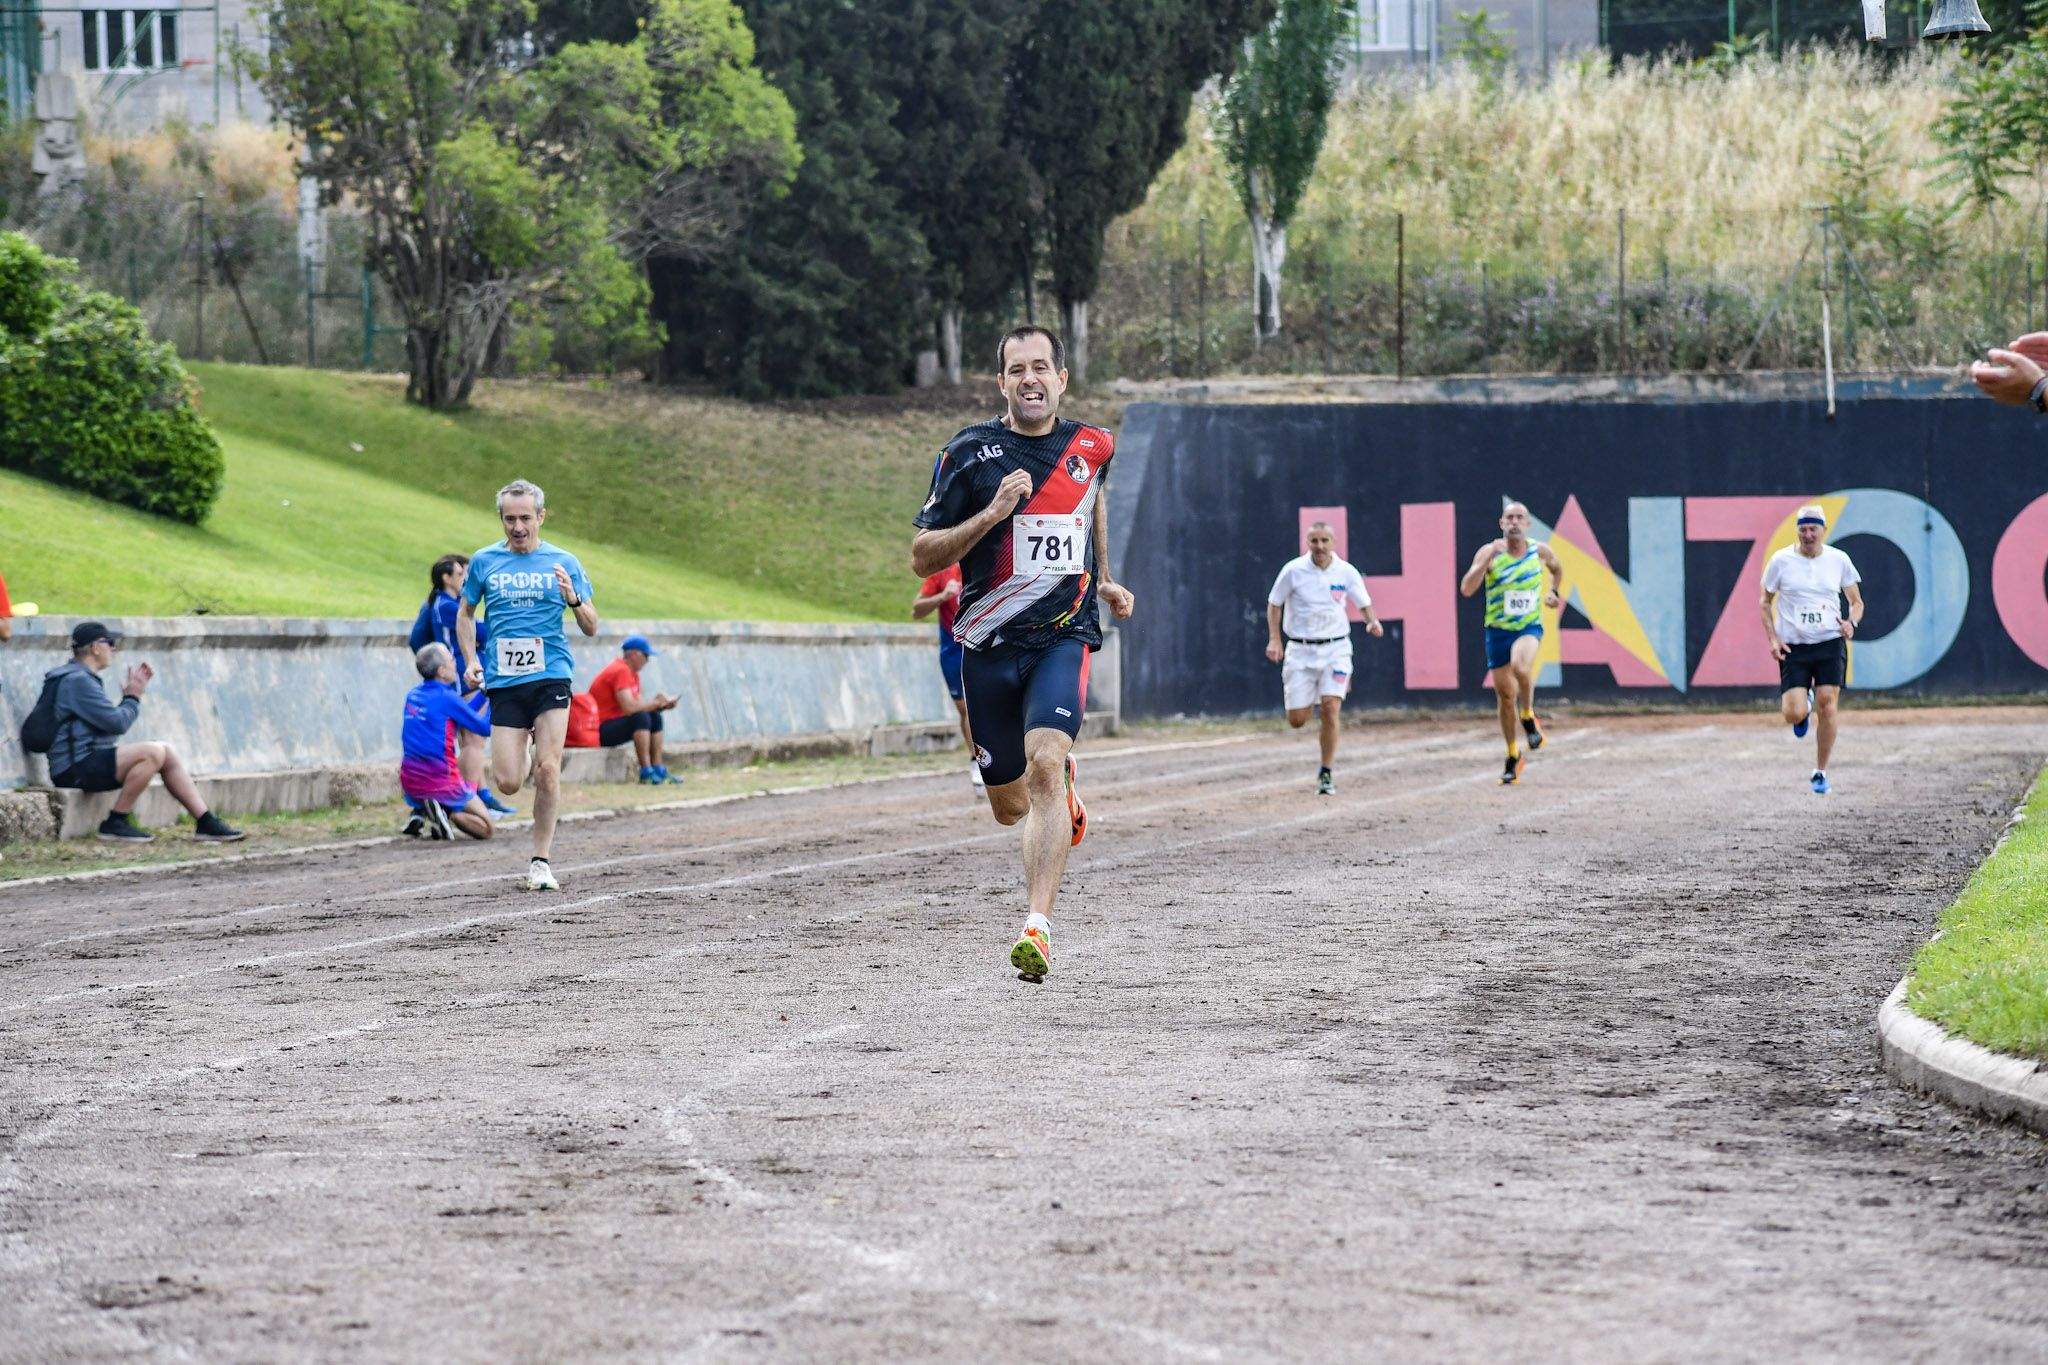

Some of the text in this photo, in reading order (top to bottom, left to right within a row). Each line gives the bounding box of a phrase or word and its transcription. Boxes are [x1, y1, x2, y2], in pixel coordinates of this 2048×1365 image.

[1027, 535, 1073, 561] 781
[488, 571, 556, 591] SPORT
[500, 588, 545, 600] Running
[510, 598, 536, 608] Club
[1800, 612, 1822, 624] 783
[505, 650, 536, 667] 722
